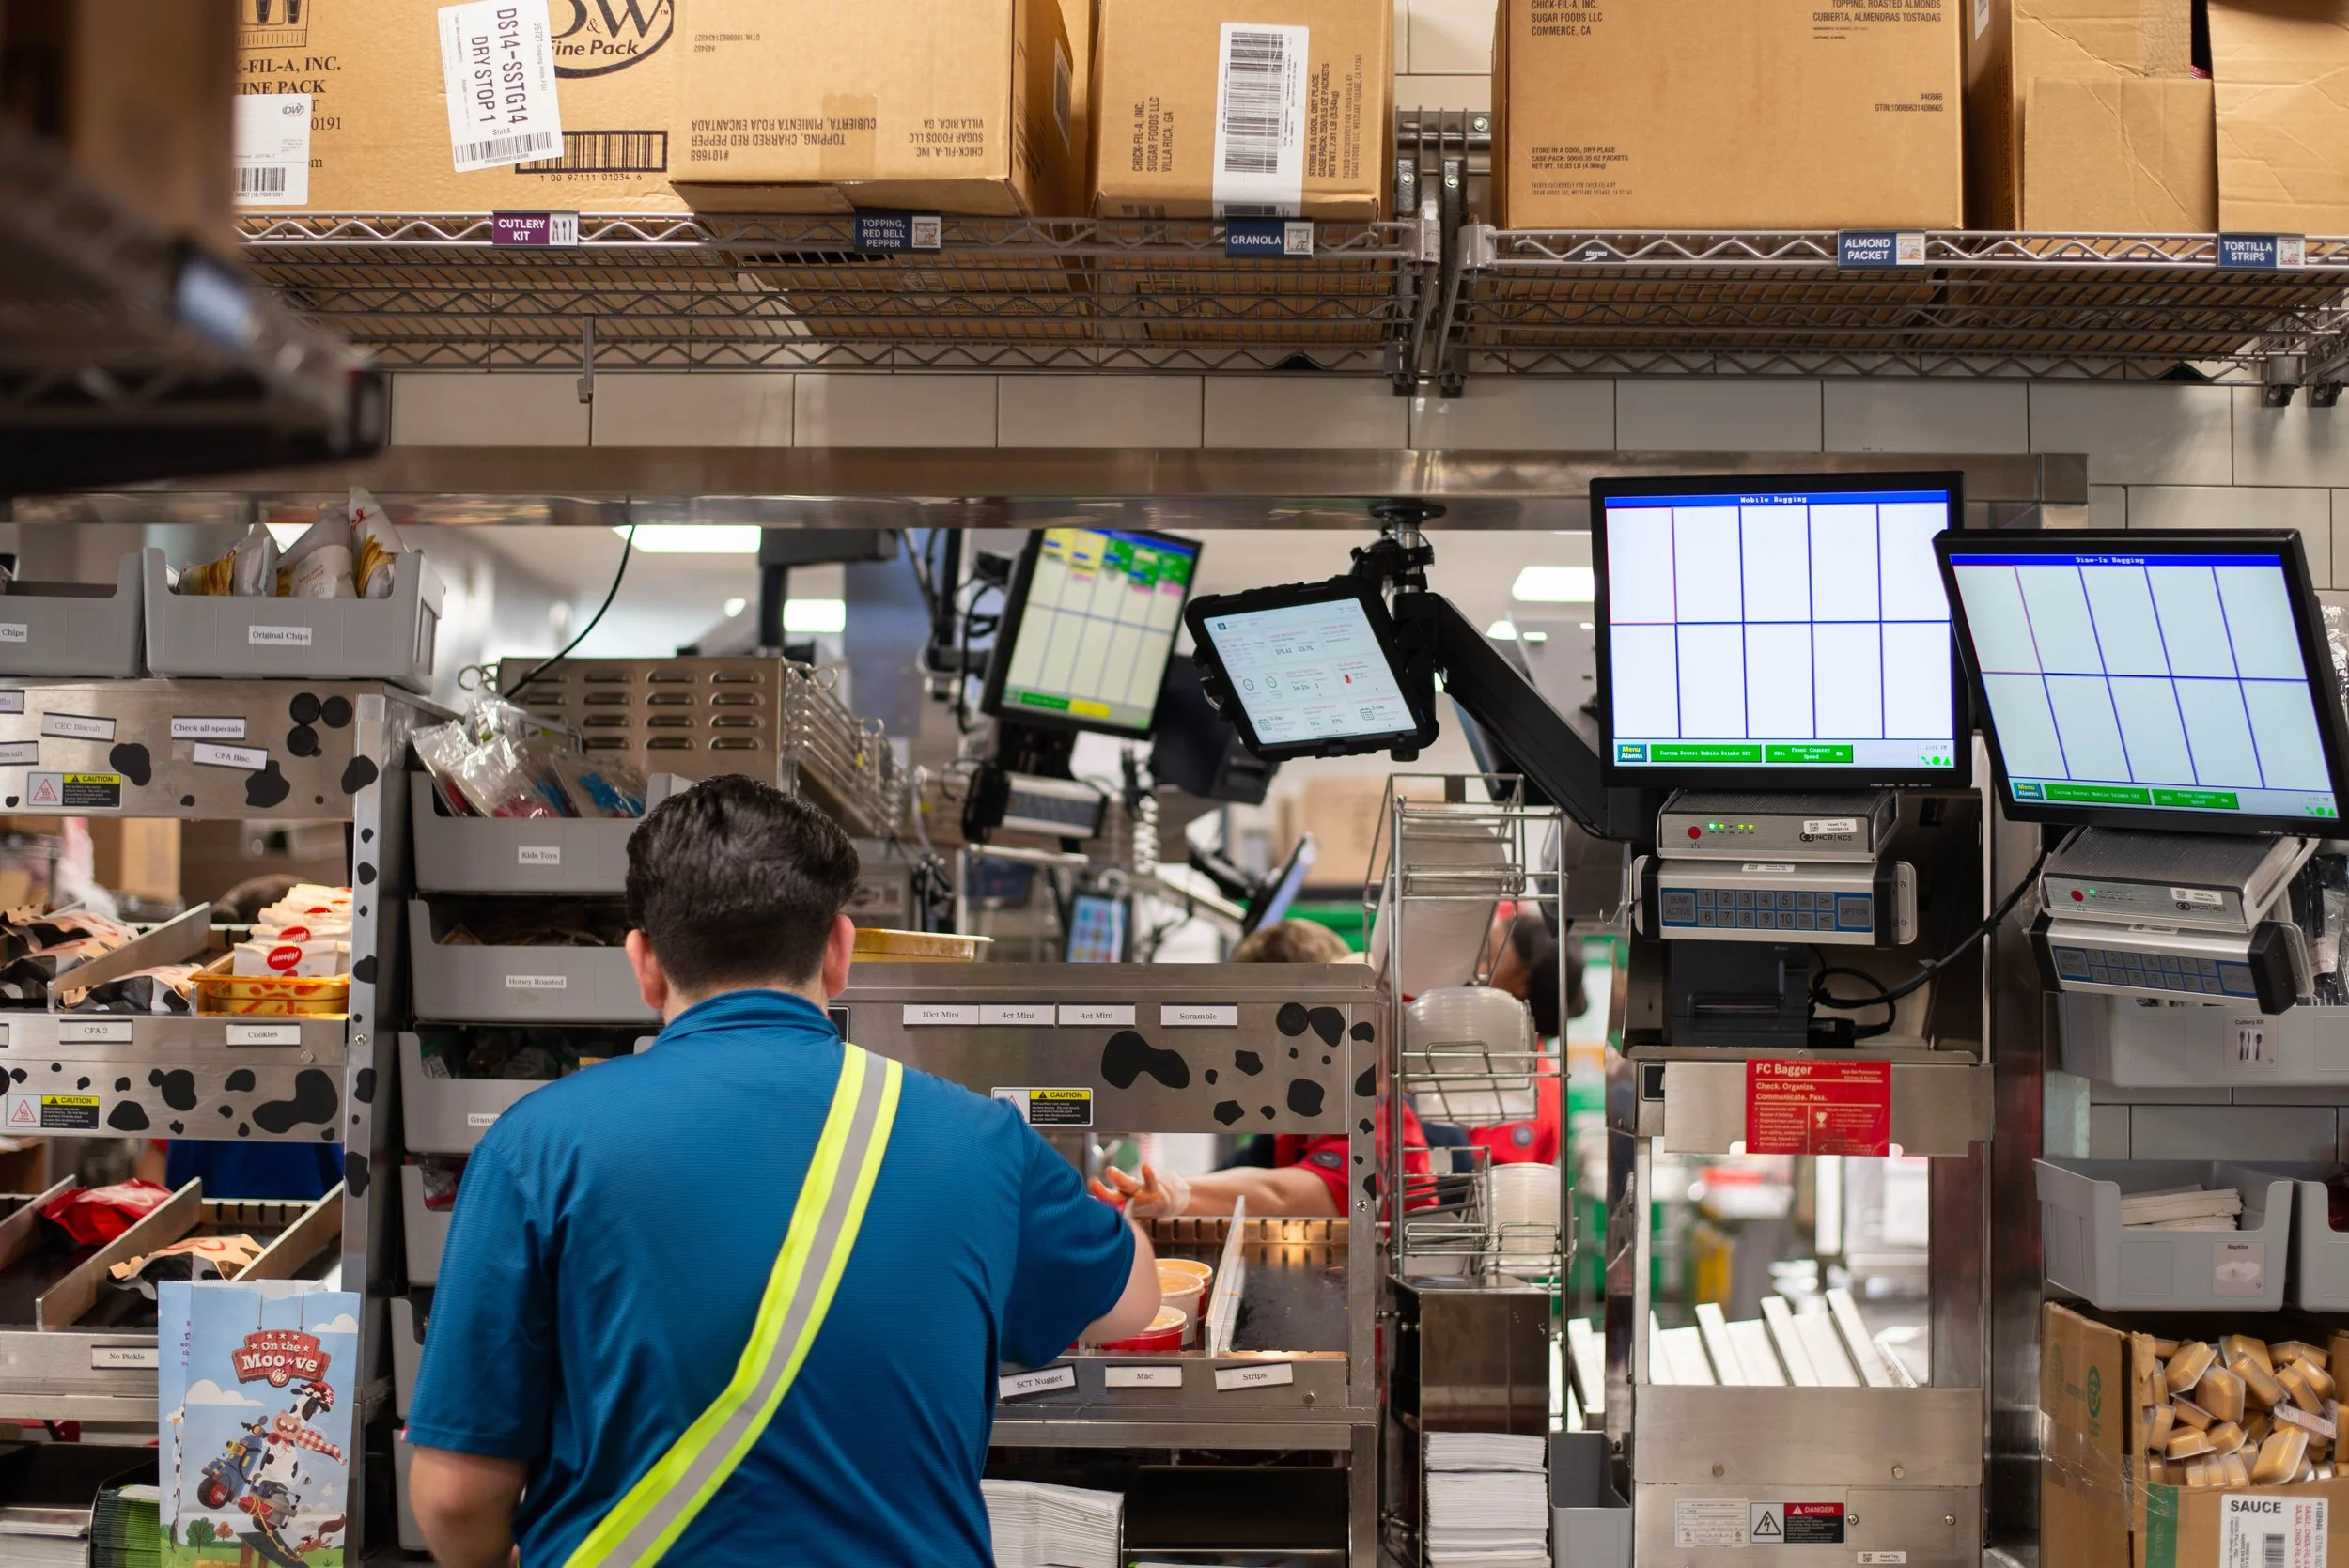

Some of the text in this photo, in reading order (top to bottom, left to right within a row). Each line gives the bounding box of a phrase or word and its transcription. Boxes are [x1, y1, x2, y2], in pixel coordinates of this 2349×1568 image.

[1532, 0, 1598, 9] CHICK-FIL-A, INC.
[1832, 0, 1941, 9] TOPPING, ROASTED ALMONDS
[1532, 12, 1603, 23] SUGAR FOODS LLC
[1812, 12, 1942, 23] CUBIERTA, ALMENDRAS TOSTADAS
[1532, 25, 1591, 37] COMMERCE, CA
[590, 39, 640, 56] Pack
[305, 56, 341, 71] INC.
[496, 8, 528, 124] DS14-SSTG14
[471, 35, 496, 123] DRY STOP 1
[278, 79, 326, 94] PACK
[1134, 101, 1145, 118] INC.
[1163, 111, 1174, 122] GA
[691, 118, 877, 132] CUBIERTA, PIMIENTA ROJA ENCANTADA
[924, 118, 984, 130] VILLA RICA, GA
[691, 133, 846, 147] TOPPING, CHARRED RED PEPPER
[909, 132, 984, 143] SUGAR FOODS LLC
[1147, 97, 1159, 172] SUGAR FOODS LLC
[691, 149, 730, 162] #101668
[913, 146, 983, 158] CHICK-FIL-A, INC.
[1161, 149, 1173, 173] VILLA
[540, 174, 545, 182] 1
[551, 174, 562, 182] 00
[568, 174, 596, 182] 97111
[601, 174, 630, 182] 01034
[498, 219, 545, 231] CUTLERY
[862, 219, 906, 228] TOPPING,
[513, 230, 530, 241] KIT
[863, 229, 905, 238] RED BELL
[866, 239, 901, 248] PEPPER
[1230, 235, 1282, 246] GRANOLA
[1844, 239, 1891, 248] ALMOND
[2223, 241, 2273, 251] TORTILLA
[1847, 250, 1889, 259] PACKET
[2231, 252, 2265, 261] STRIPS
[1773, 495, 1807, 504] Bagging
[2111, 556, 2145, 565] Bagging
[2, 629, 25, 637] Chips
[252, 630, 309, 641] Original Chips
[54, 722, 101, 733] CEC Biscuit
[174, 723, 197, 732] Check
[210, 725, 242, 734] specials
[214, 752, 252, 763] CFA Bisc.
[521, 851, 558, 861] Kids Toys
[1704, 893, 1789, 905] 1 2 3 4 5
[1704, 911, 1792, 924] 6 7 8 9 10
[508, 977, 564, 986] Honey Roasted
[1001, 1011, 1034, 1019] 4ct Mini
[1096, 1011, 1113, 1019] Mini
[1179, 1011, 1218, 1020] Scramble
[84, 1026, 100, 1035] CFA
[247, 1030, 279, 1040] Cookies
[1756, 1063, 1812, 1077] FC Bagger
[1756, 1082, 1816, 1092] Check. Organize.
[1756, 1093, 1828, 1101] Communicate. Pass.
[470, 1116, 497, 1125] Granol
[261, 1341, 301, 1352] On the
[109, 1352, 146, 1361] No Pickle
[1016, 1374, 1063, 1389] 5CT Nugget
[1242, 1372, 1268, 1382] Strips
[2230, 1500, 2282, 1514] SAUCE
